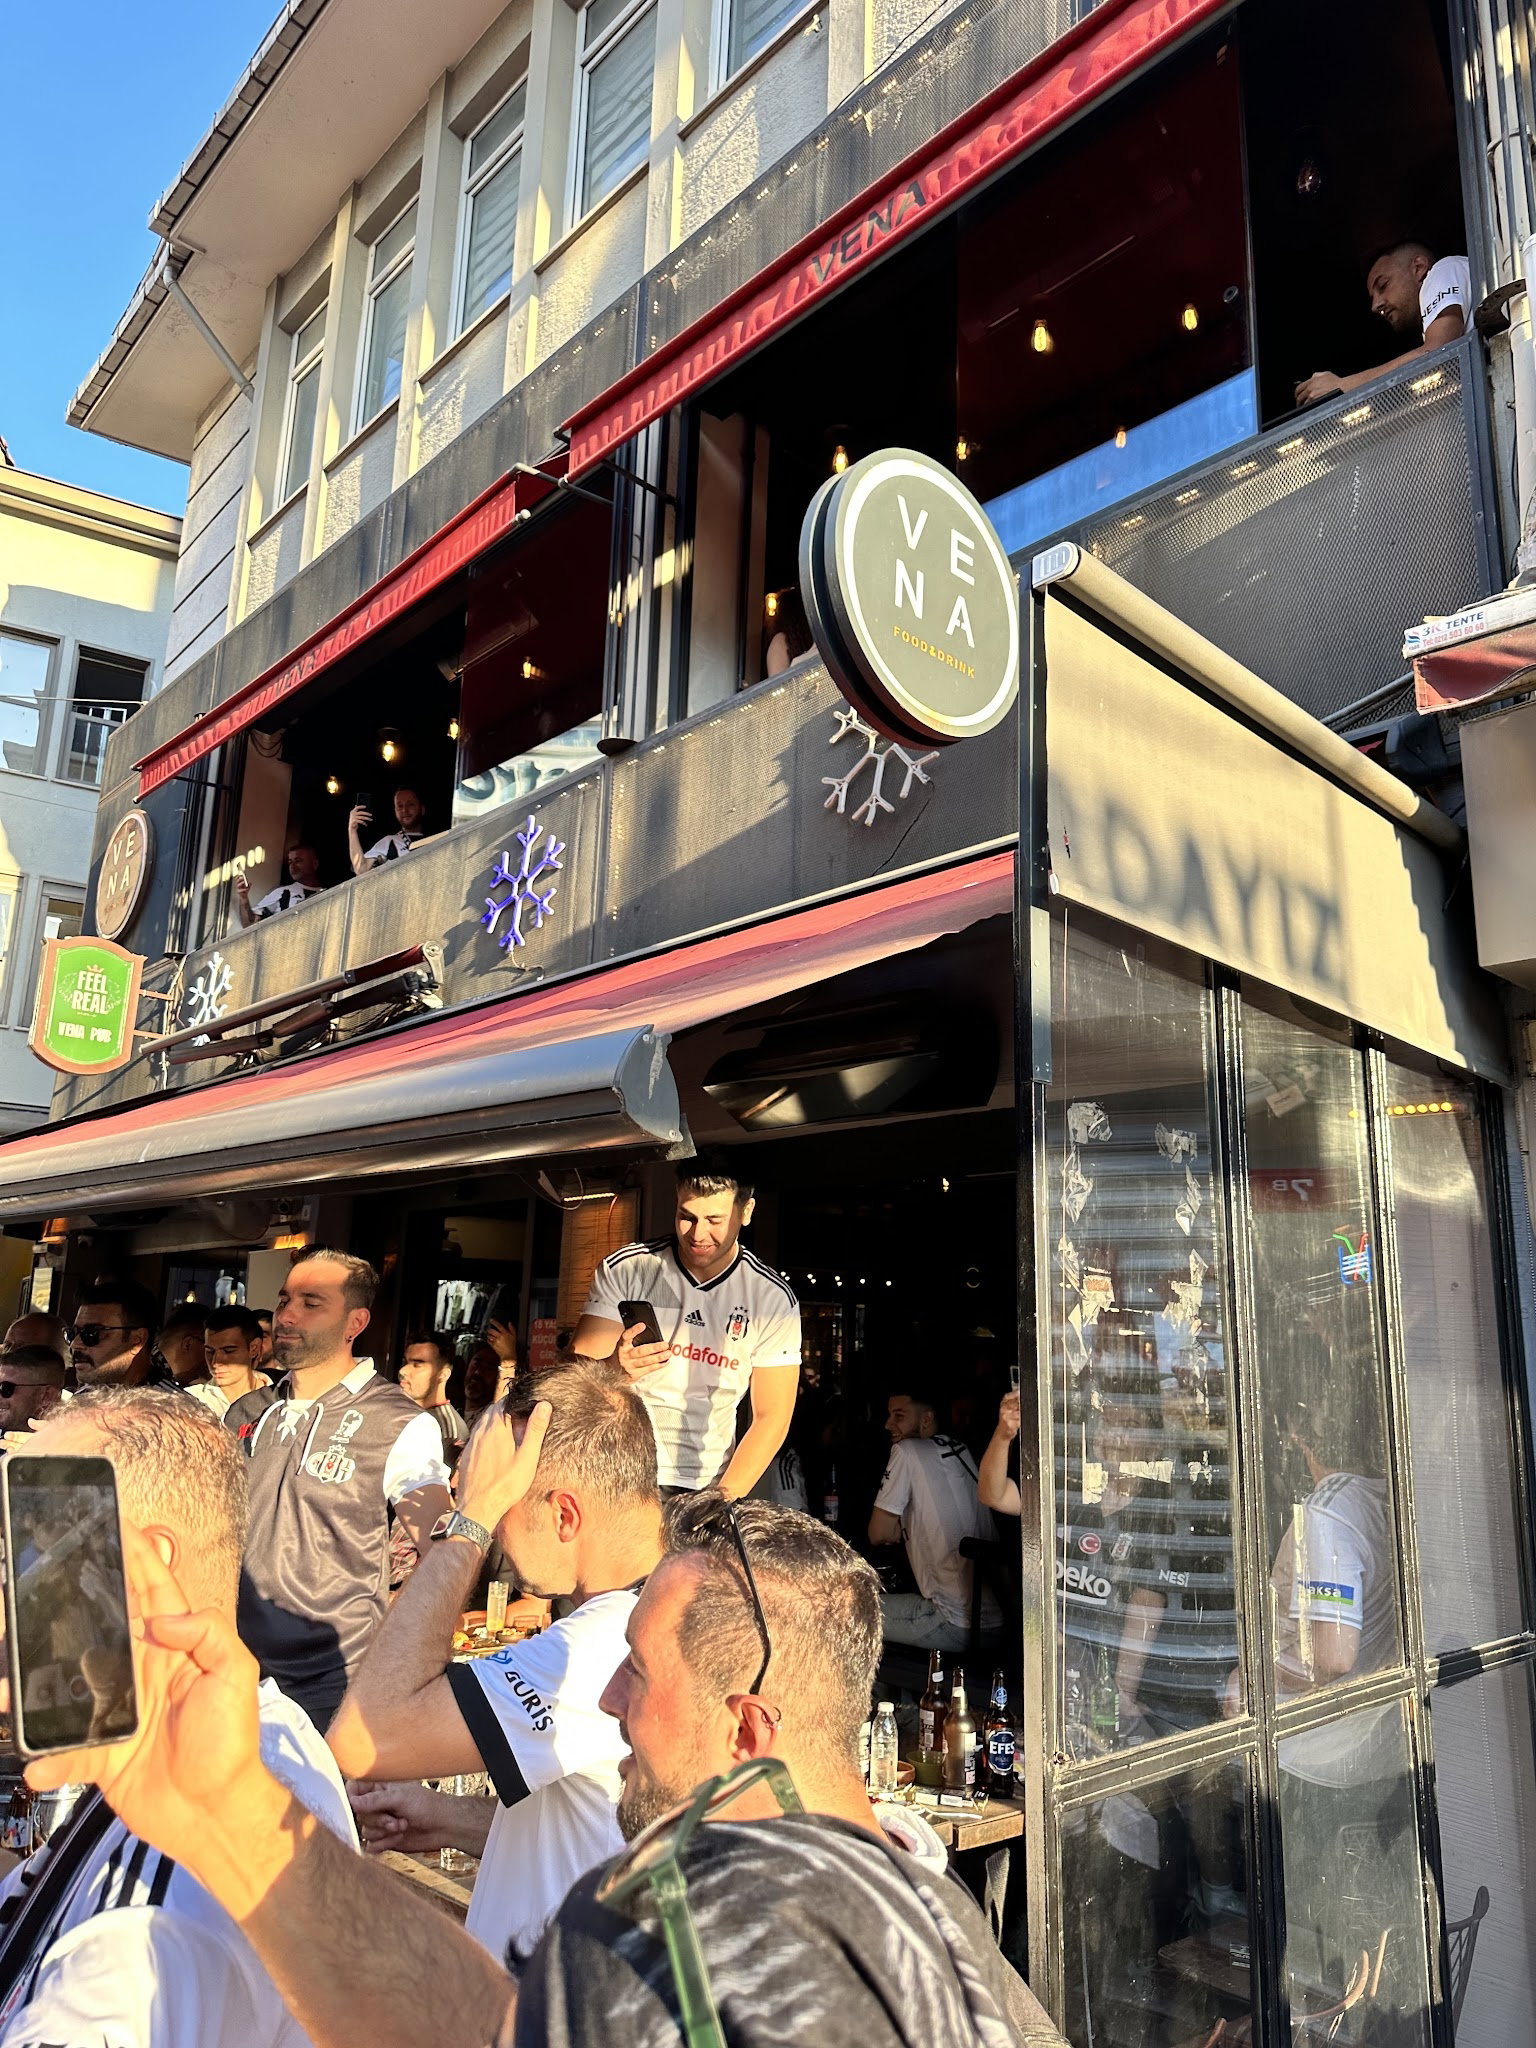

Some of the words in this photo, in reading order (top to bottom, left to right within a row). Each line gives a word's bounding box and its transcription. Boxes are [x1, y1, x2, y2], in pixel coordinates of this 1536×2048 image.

[811, 181, 926, 282] VENA
[1446, 612, 1484, 629] TENTE
[893, 626, 976, 679] FOOD&DRINK
[78, 970, 108, 994] FEEL
[72, 989, 109, 1015] REAL
[58, 1021, 85, 1039] VENA
[90, 1026, 112, 1043] PUB
[670, 1342, 739, 1370] odafone
[989, 1740, 1016, 1756] EFES
